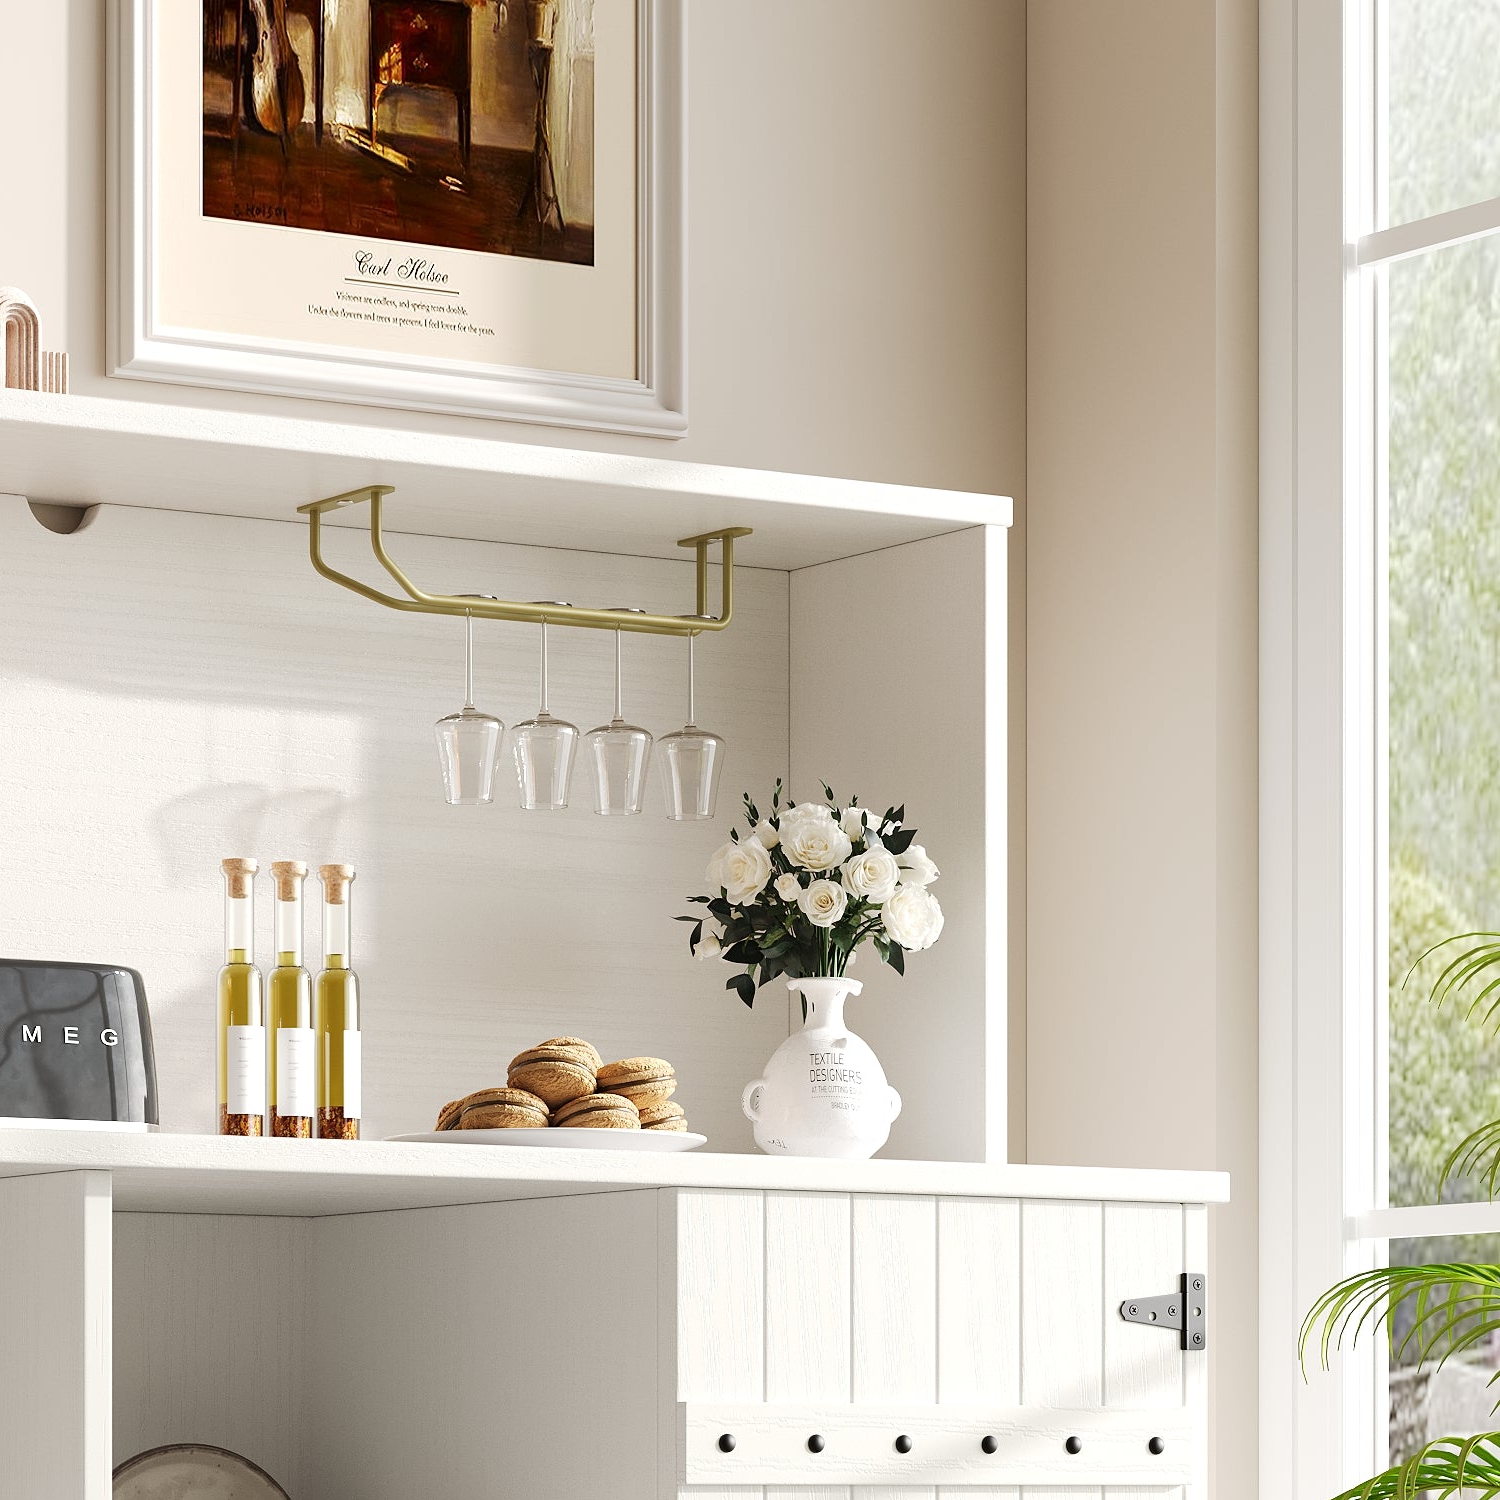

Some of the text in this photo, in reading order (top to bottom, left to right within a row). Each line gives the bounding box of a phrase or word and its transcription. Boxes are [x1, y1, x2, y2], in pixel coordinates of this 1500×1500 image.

[355, 250, 392, 275] Carl
[809, 1053, 844, 1065] TEXTILE
[810, 1068, 862, 1084] DESIGNERS
